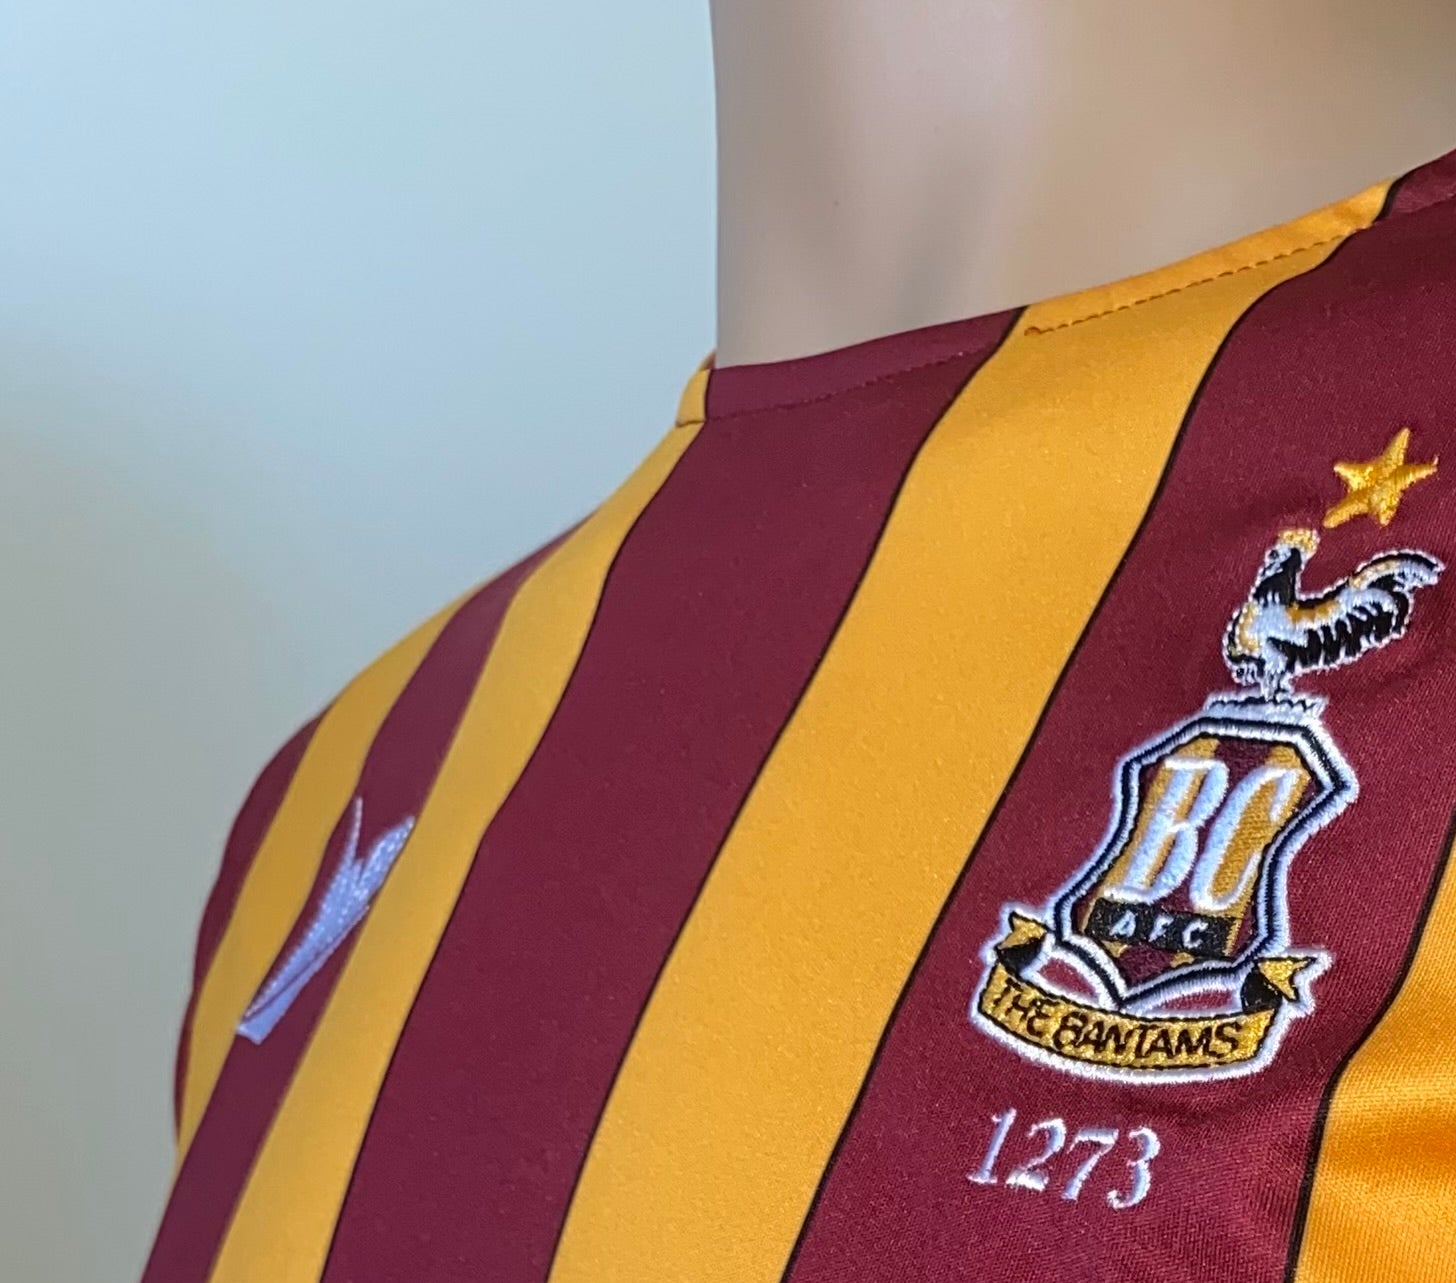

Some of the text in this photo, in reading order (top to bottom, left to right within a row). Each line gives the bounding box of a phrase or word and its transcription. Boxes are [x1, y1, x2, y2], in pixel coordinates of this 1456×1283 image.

[1102, 757, 1297, 912] BC
[1109, 910, 1208, 949] AFC
[994, 977, 1243, 1060] THE BANTAMS
[966, 1108, 1160, 1209] 1273
